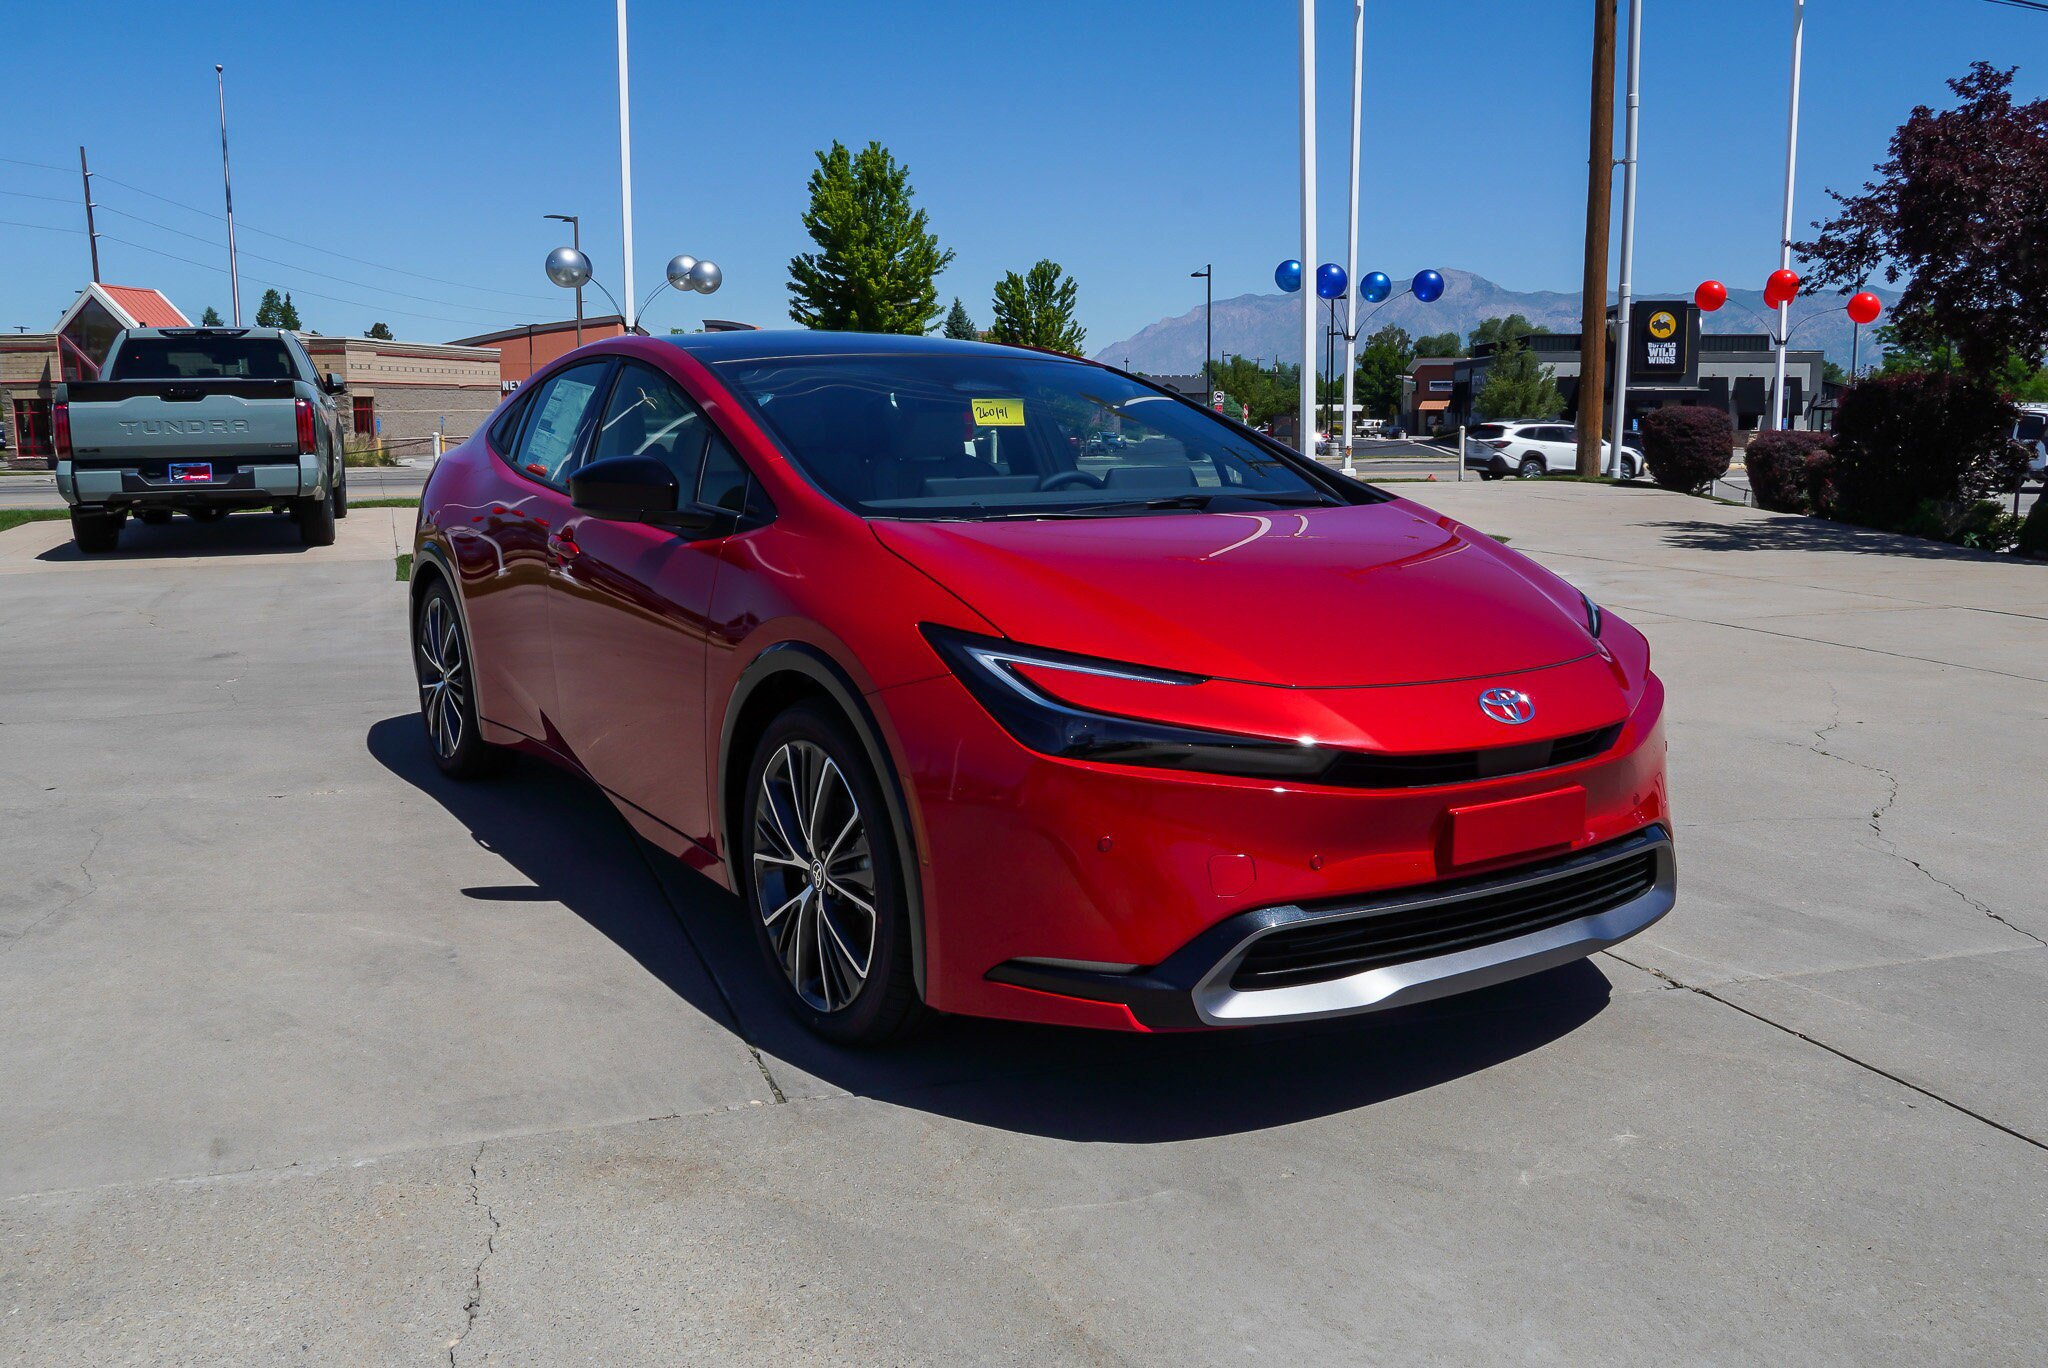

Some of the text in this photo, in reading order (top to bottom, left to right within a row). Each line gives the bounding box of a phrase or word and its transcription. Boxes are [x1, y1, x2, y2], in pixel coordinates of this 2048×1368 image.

[1648, 348, 1676, 356] WILD
[1647, 356, 1676, 364] WINGS
[118, 419, 250, 436] TUNDRA
